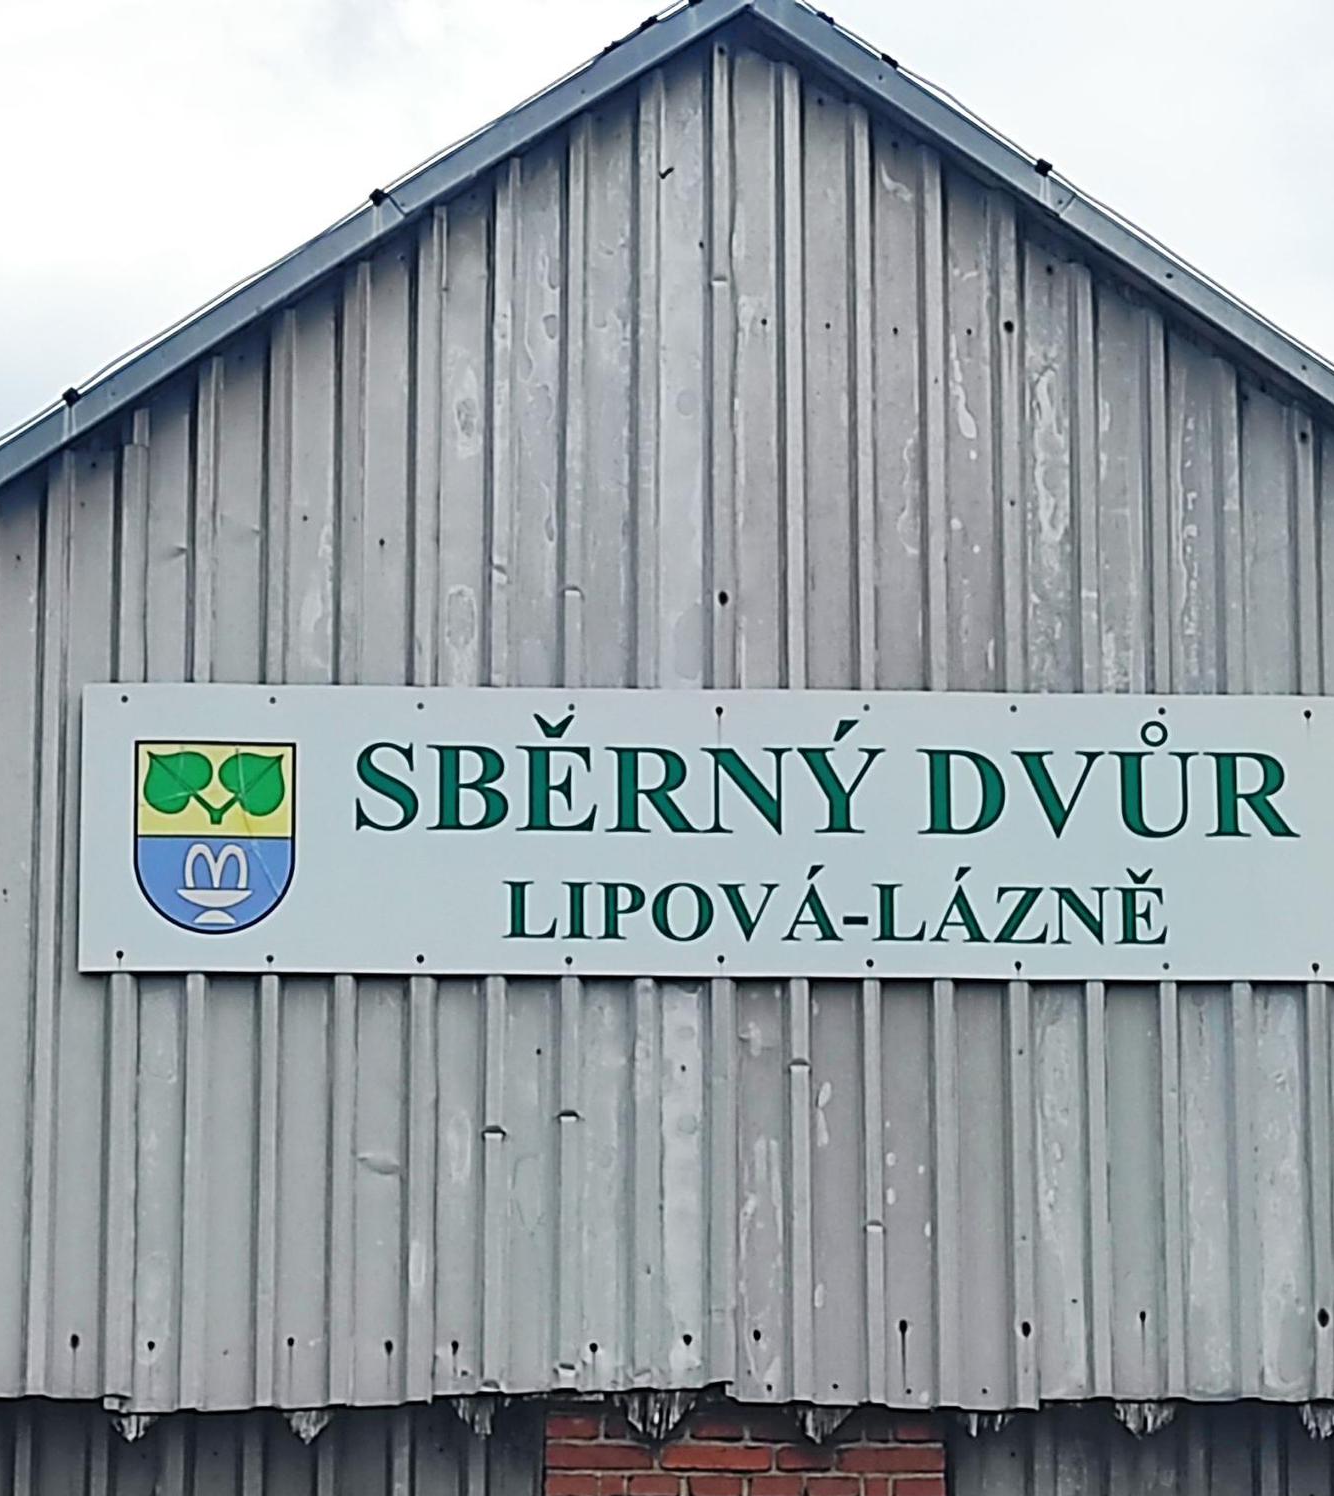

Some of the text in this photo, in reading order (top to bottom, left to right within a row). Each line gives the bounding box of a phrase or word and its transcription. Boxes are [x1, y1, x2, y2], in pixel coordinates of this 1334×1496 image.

[354, 713, 1301, 841] SBĚRNÝ DVŮR
[501, 863, 1170, 947] LIPOVÁ-LÁZNĚ
